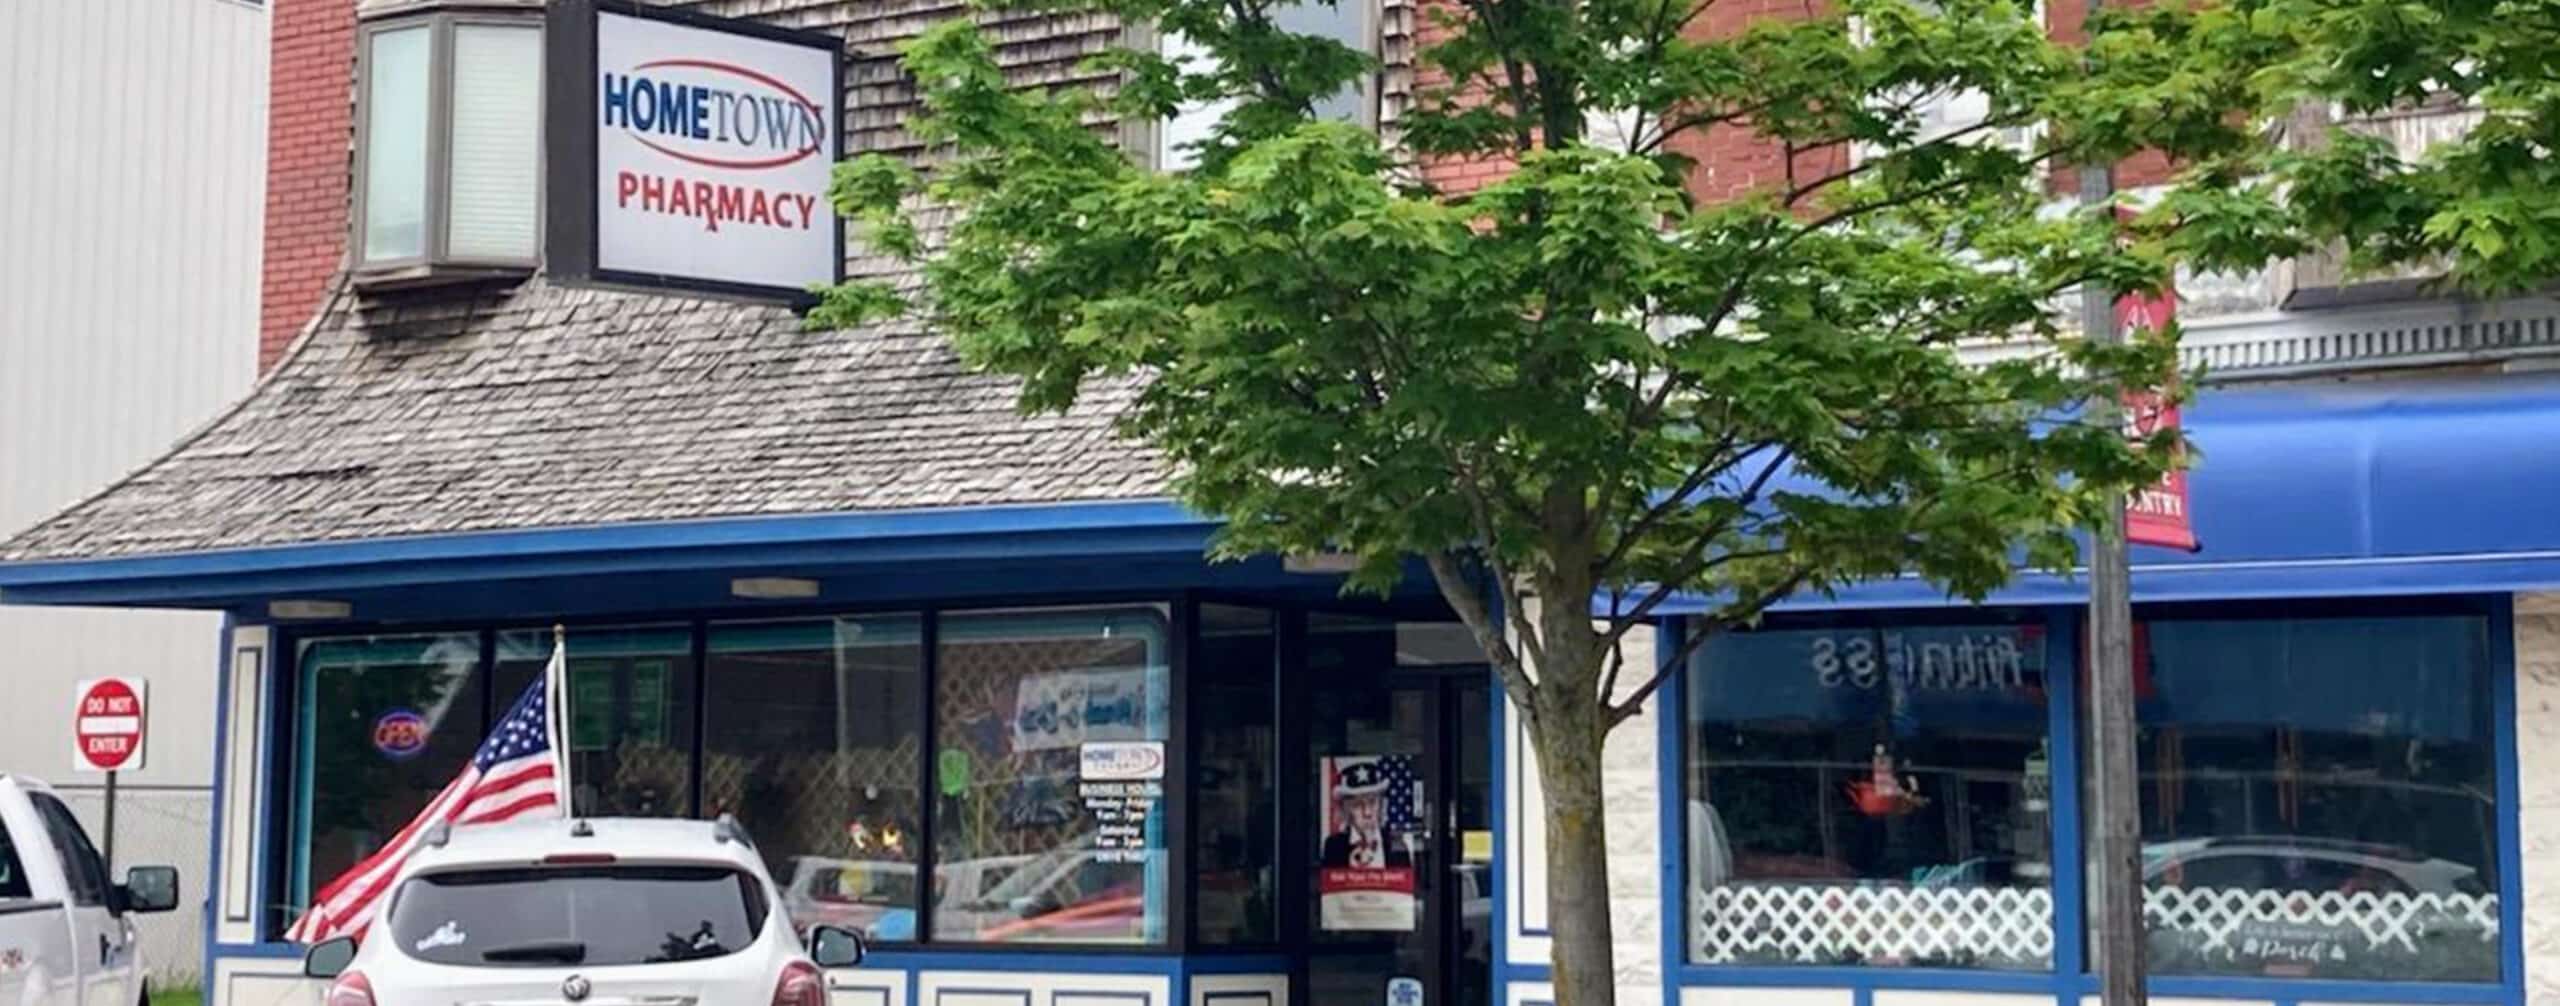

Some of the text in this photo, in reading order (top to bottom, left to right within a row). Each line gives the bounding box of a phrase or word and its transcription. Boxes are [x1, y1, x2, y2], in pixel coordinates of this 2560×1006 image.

[604, 72, 826, 154] HOMETOWN
[617, 171, 816, 232] PHARMACY
[86, 696, 132, 714] DO NOT
[88, 737, 128, 754] ENTER
[375, 720, 427, 746] OPEN
